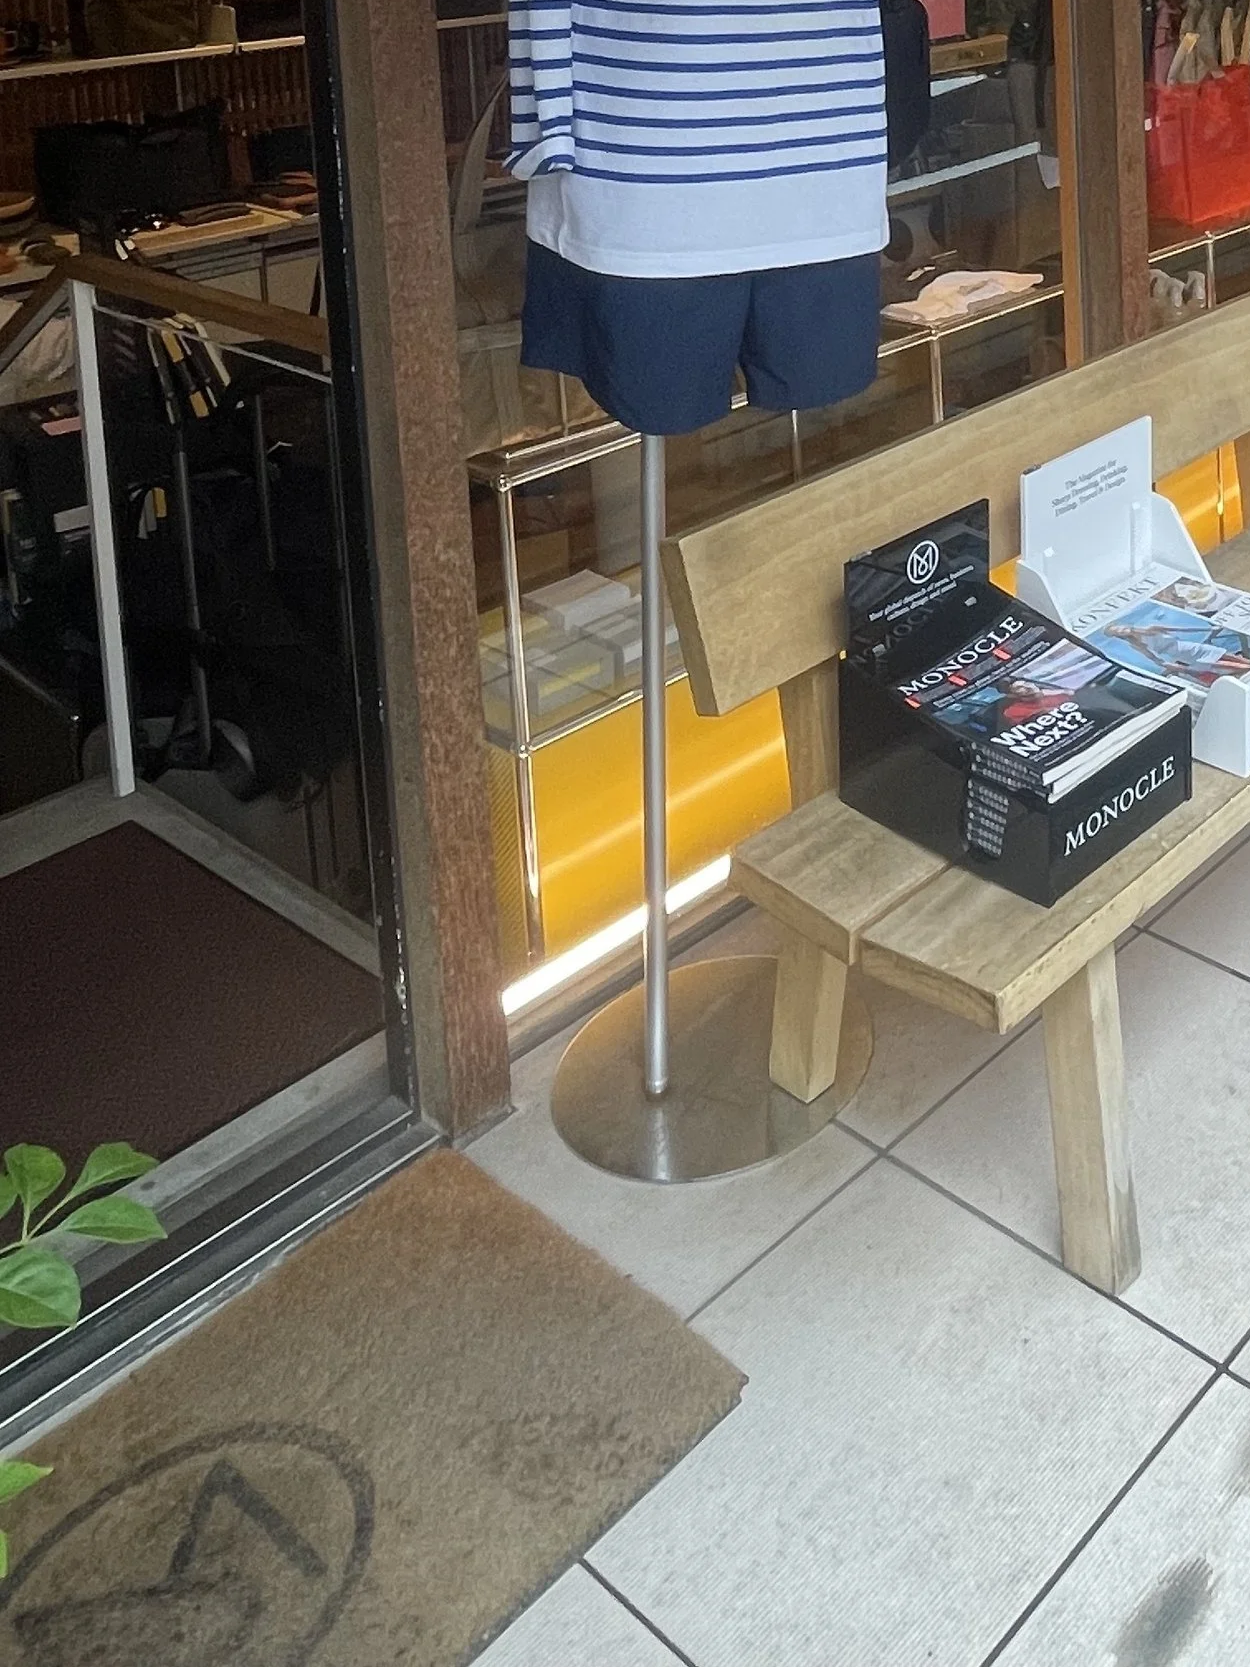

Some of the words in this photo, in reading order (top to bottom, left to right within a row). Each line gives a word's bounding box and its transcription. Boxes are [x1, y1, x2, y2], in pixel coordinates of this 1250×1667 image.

[897, 615, 1024, 696] MONOCLE
[990, 701, 1080, 746] Where
[1008, 710, 1088, 758] Next?
[1064, 755, 1175, 856] MONOCLE
